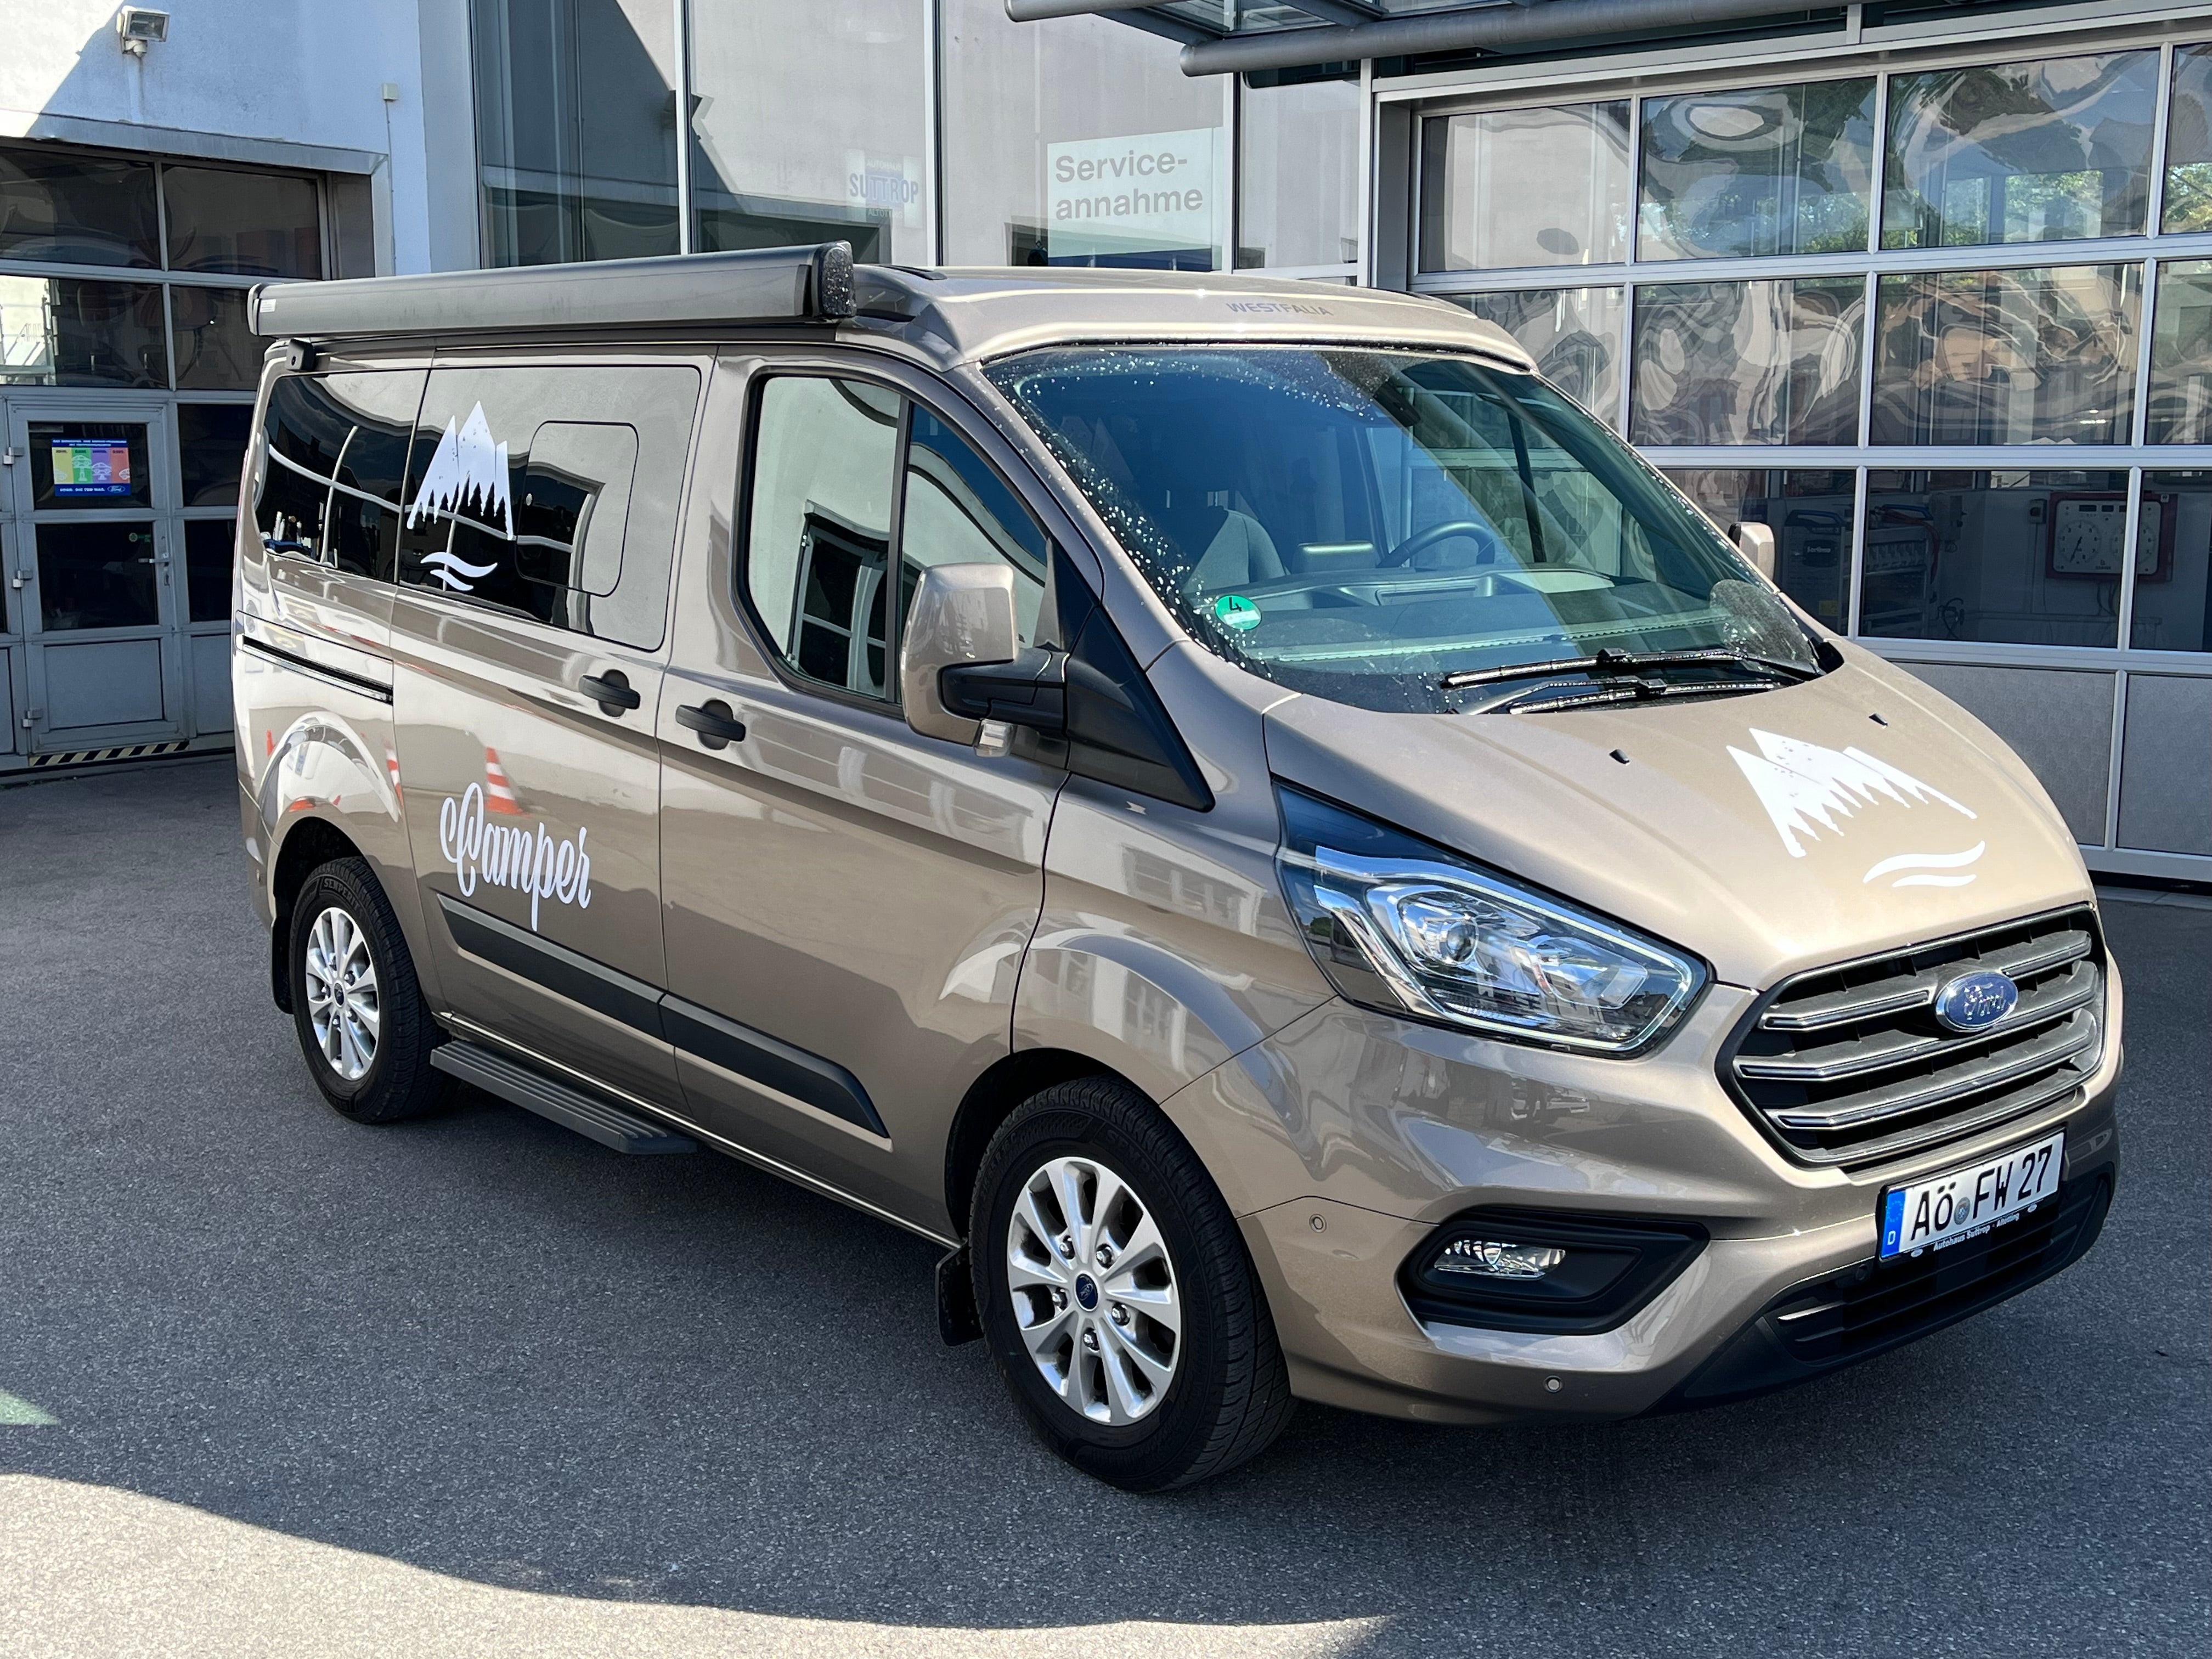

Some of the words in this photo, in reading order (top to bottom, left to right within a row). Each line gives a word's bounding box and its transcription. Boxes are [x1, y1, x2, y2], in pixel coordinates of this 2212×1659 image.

[1056, 150, 1187, 183] Service-
[849, 173, 918, 204] SUTTROP
[1056, 188, 1203, 221] annahme
[1226, 302, 1333, 316] WESTFALIA
[1229, 597, 1242, 612] 4
[440, 782, 591, 932] Camper
[1910, 1182, 1956, 1240] AÖ
[1973, 1161, 2014, 1219] FW
[2018, 1144, 2053, 1201] 27
[1887, 1231, 1896, 1245] D
